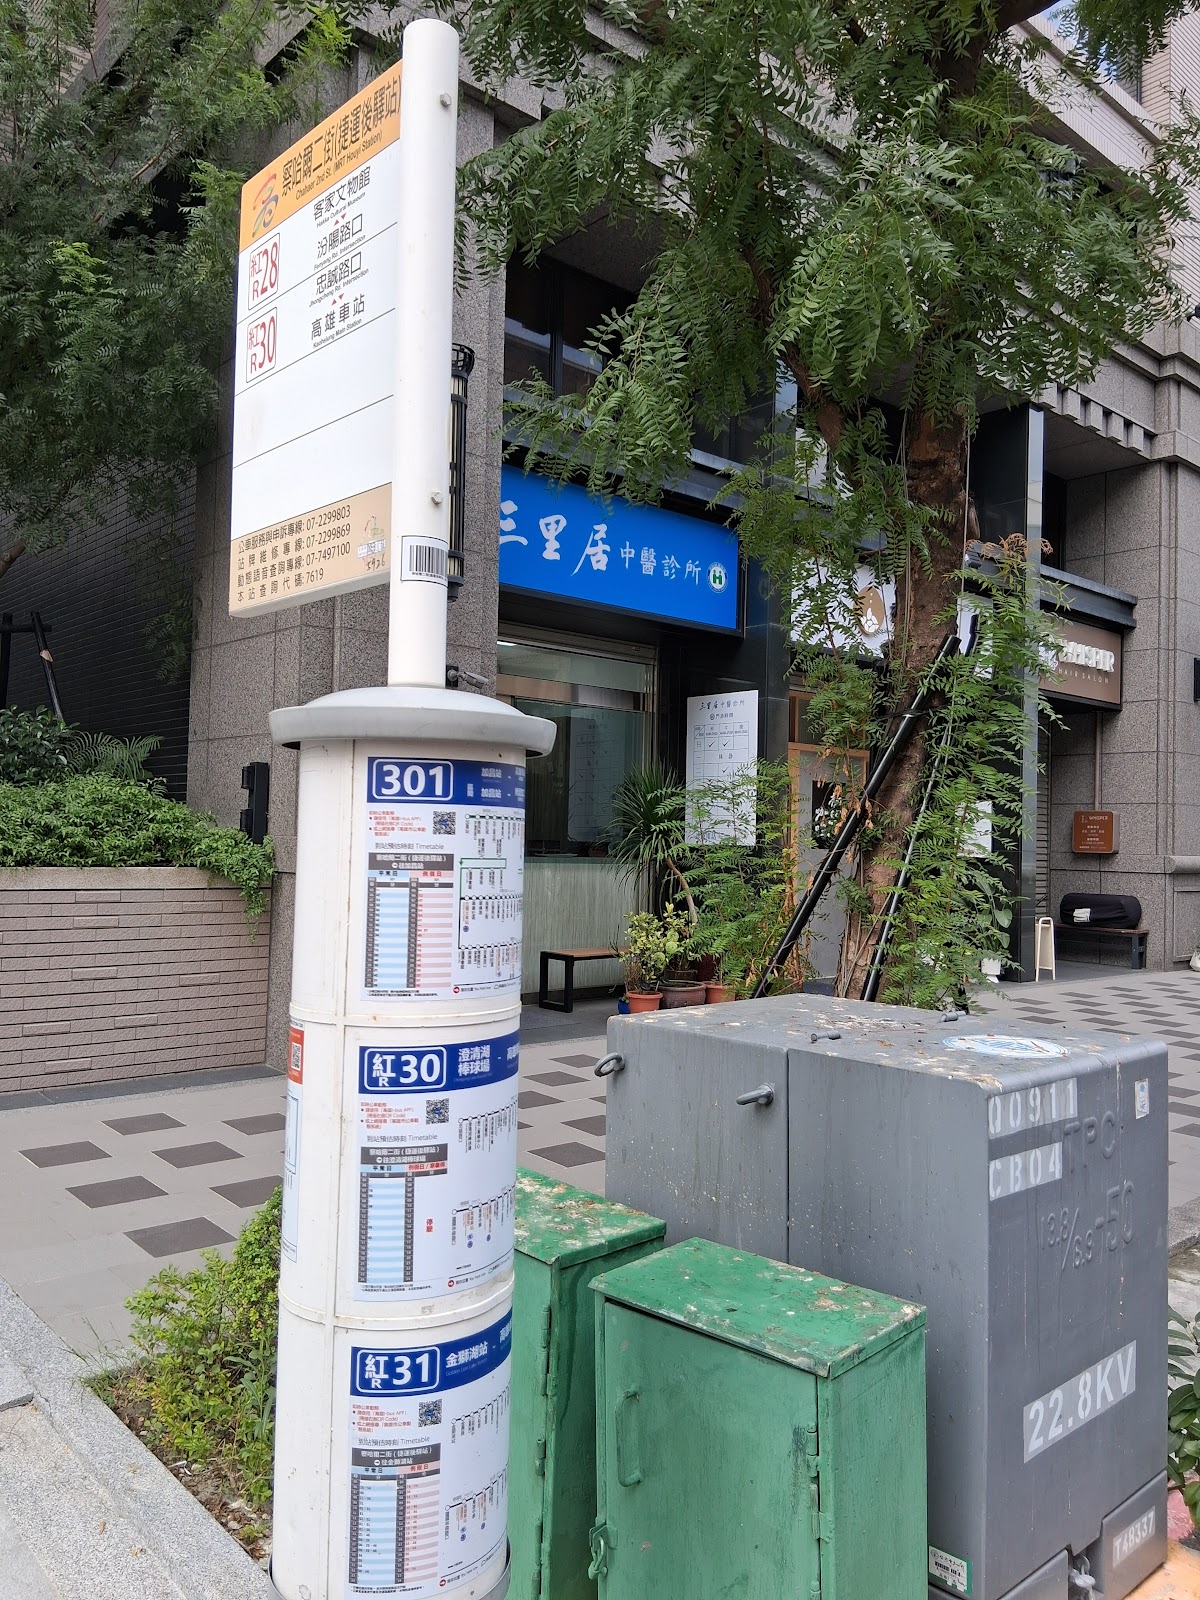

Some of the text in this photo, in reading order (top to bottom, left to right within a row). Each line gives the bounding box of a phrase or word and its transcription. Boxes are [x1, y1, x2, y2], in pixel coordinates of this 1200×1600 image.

[313, 166, 371, 221] 客家文物館
[317, 213, 362, 259] 汾陽路口
[250, 242, 279, 295] 紅 28
[316, 251, 362, 296] 忠誠路口
[252, 280, 259, 301] R
[311, 293, 365, 341] 高雄車站
[249, 316, 276, 369] 紅 30
[250, 353, 257, 374] R
[306, 505, 351, 531] 07-2299803
[306, 523, 351, 548] 07-2299869
[306, 541, 351, 566] 07-7497100
[305, 567, 324, 584] 7619
[1058, 668, 1109, 684] HAIR SALON
[381, 764, 444, 796] 301
[458, 1044, 490, 1062] 澄清湖
[372, 1053, 441, 1084] 紅 30
[378, 1076, 390, 1087] R
[458, 1059, 490, 1076] 棒球場
[408, 1133, 438, 1141] Timetable
[989, 1143, 1061, 1198] CB04
[445, 1340, 488, 1368] 金獅湖站
[365, 1353, 430, 1385] 紅 31
[371, 1378, 382, 1389] R
[1027, 1345, 1134, 1453] 22.8KV
[1114, 1510, 1154, 1561] T48337
